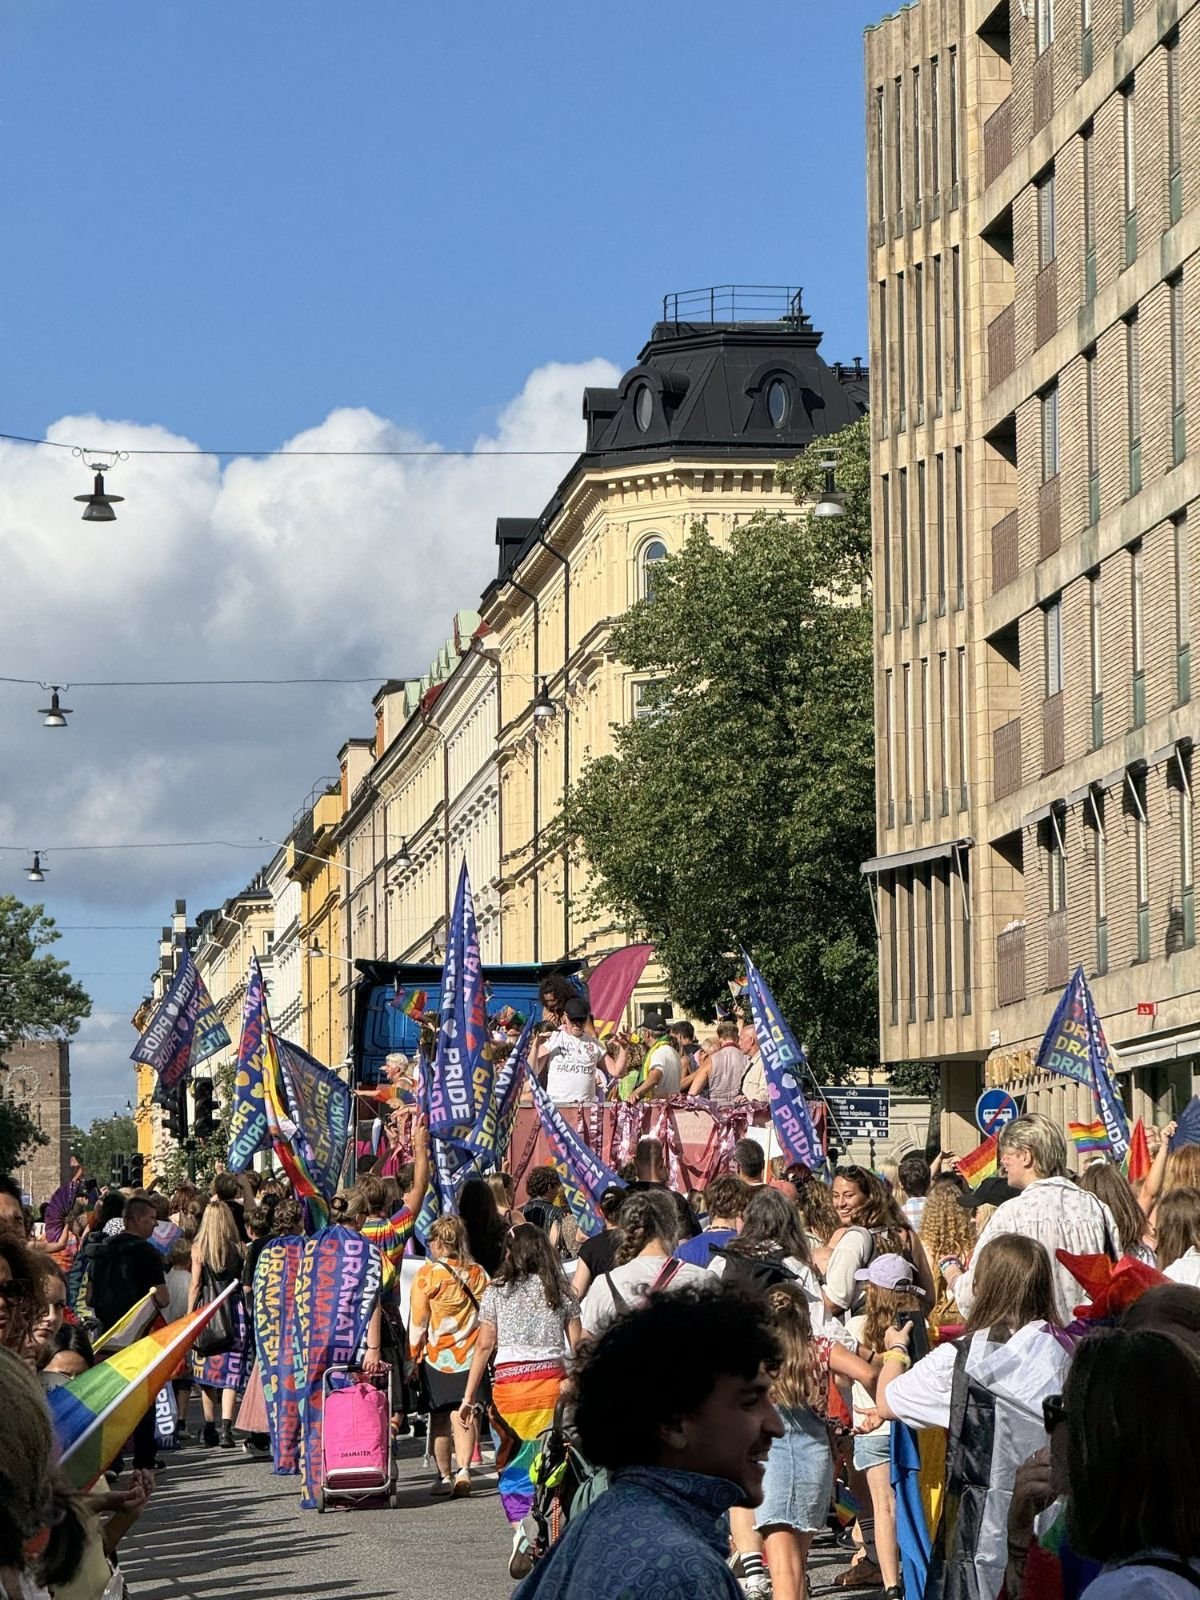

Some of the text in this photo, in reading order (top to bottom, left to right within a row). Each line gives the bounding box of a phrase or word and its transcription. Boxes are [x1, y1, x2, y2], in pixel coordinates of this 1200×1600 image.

[443, 1047, 471, 1120] PRIDE
[774, 1104, 816, 1168] PRIDE
[340, 1450, 371, 1458] DRAMATEN
